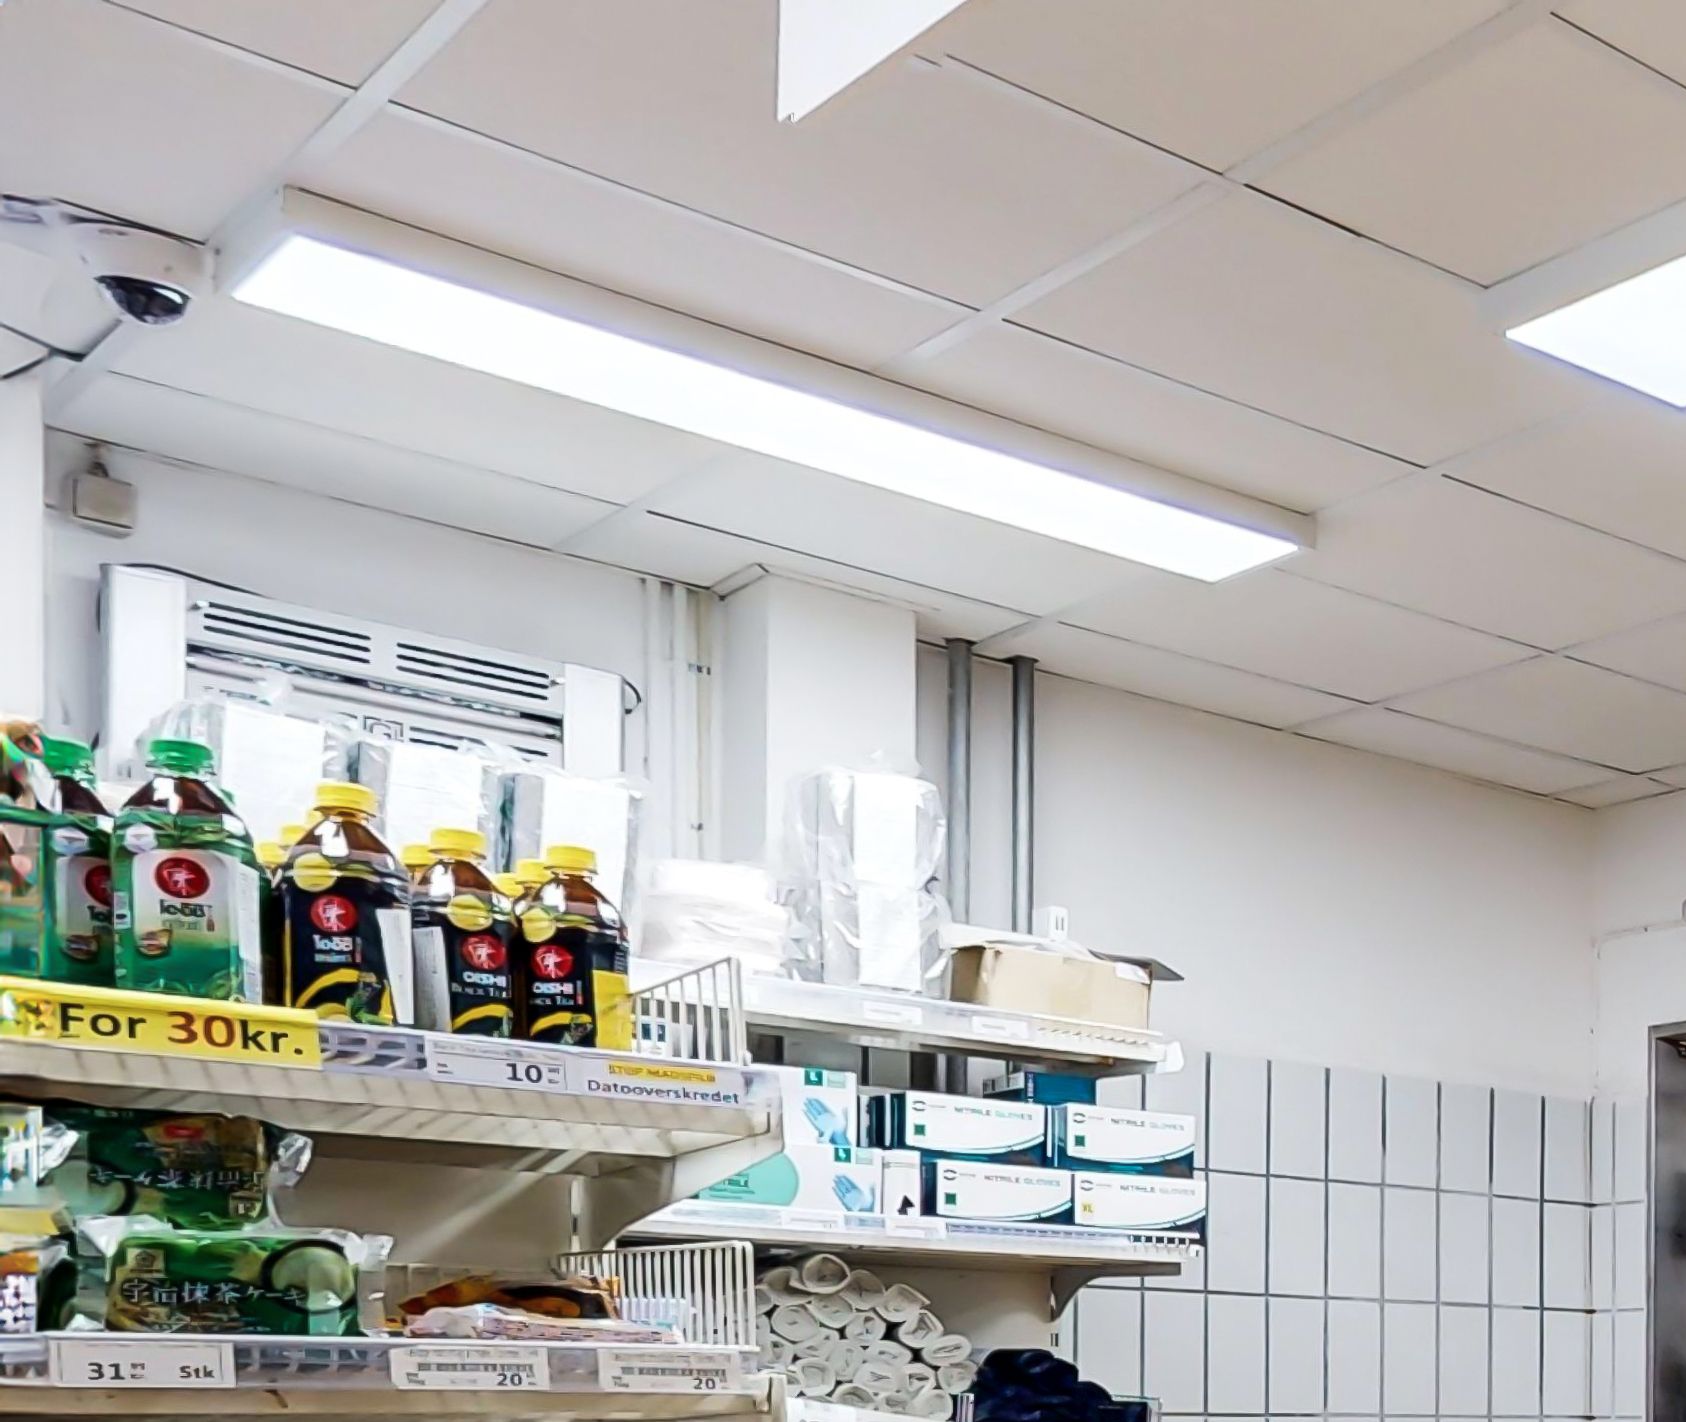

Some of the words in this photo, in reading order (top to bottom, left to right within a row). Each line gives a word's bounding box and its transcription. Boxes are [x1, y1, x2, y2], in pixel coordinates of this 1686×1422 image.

[58, 1003, 147, 1038] For
[167, 1010, 304, 1055] 30kr.
[506, 1063, 542, 1083] 10
[87, 1361, 126, 1380] 31
[496, 1373, 523, 1387] 20
[693, 1378, 716, 1390] 20
